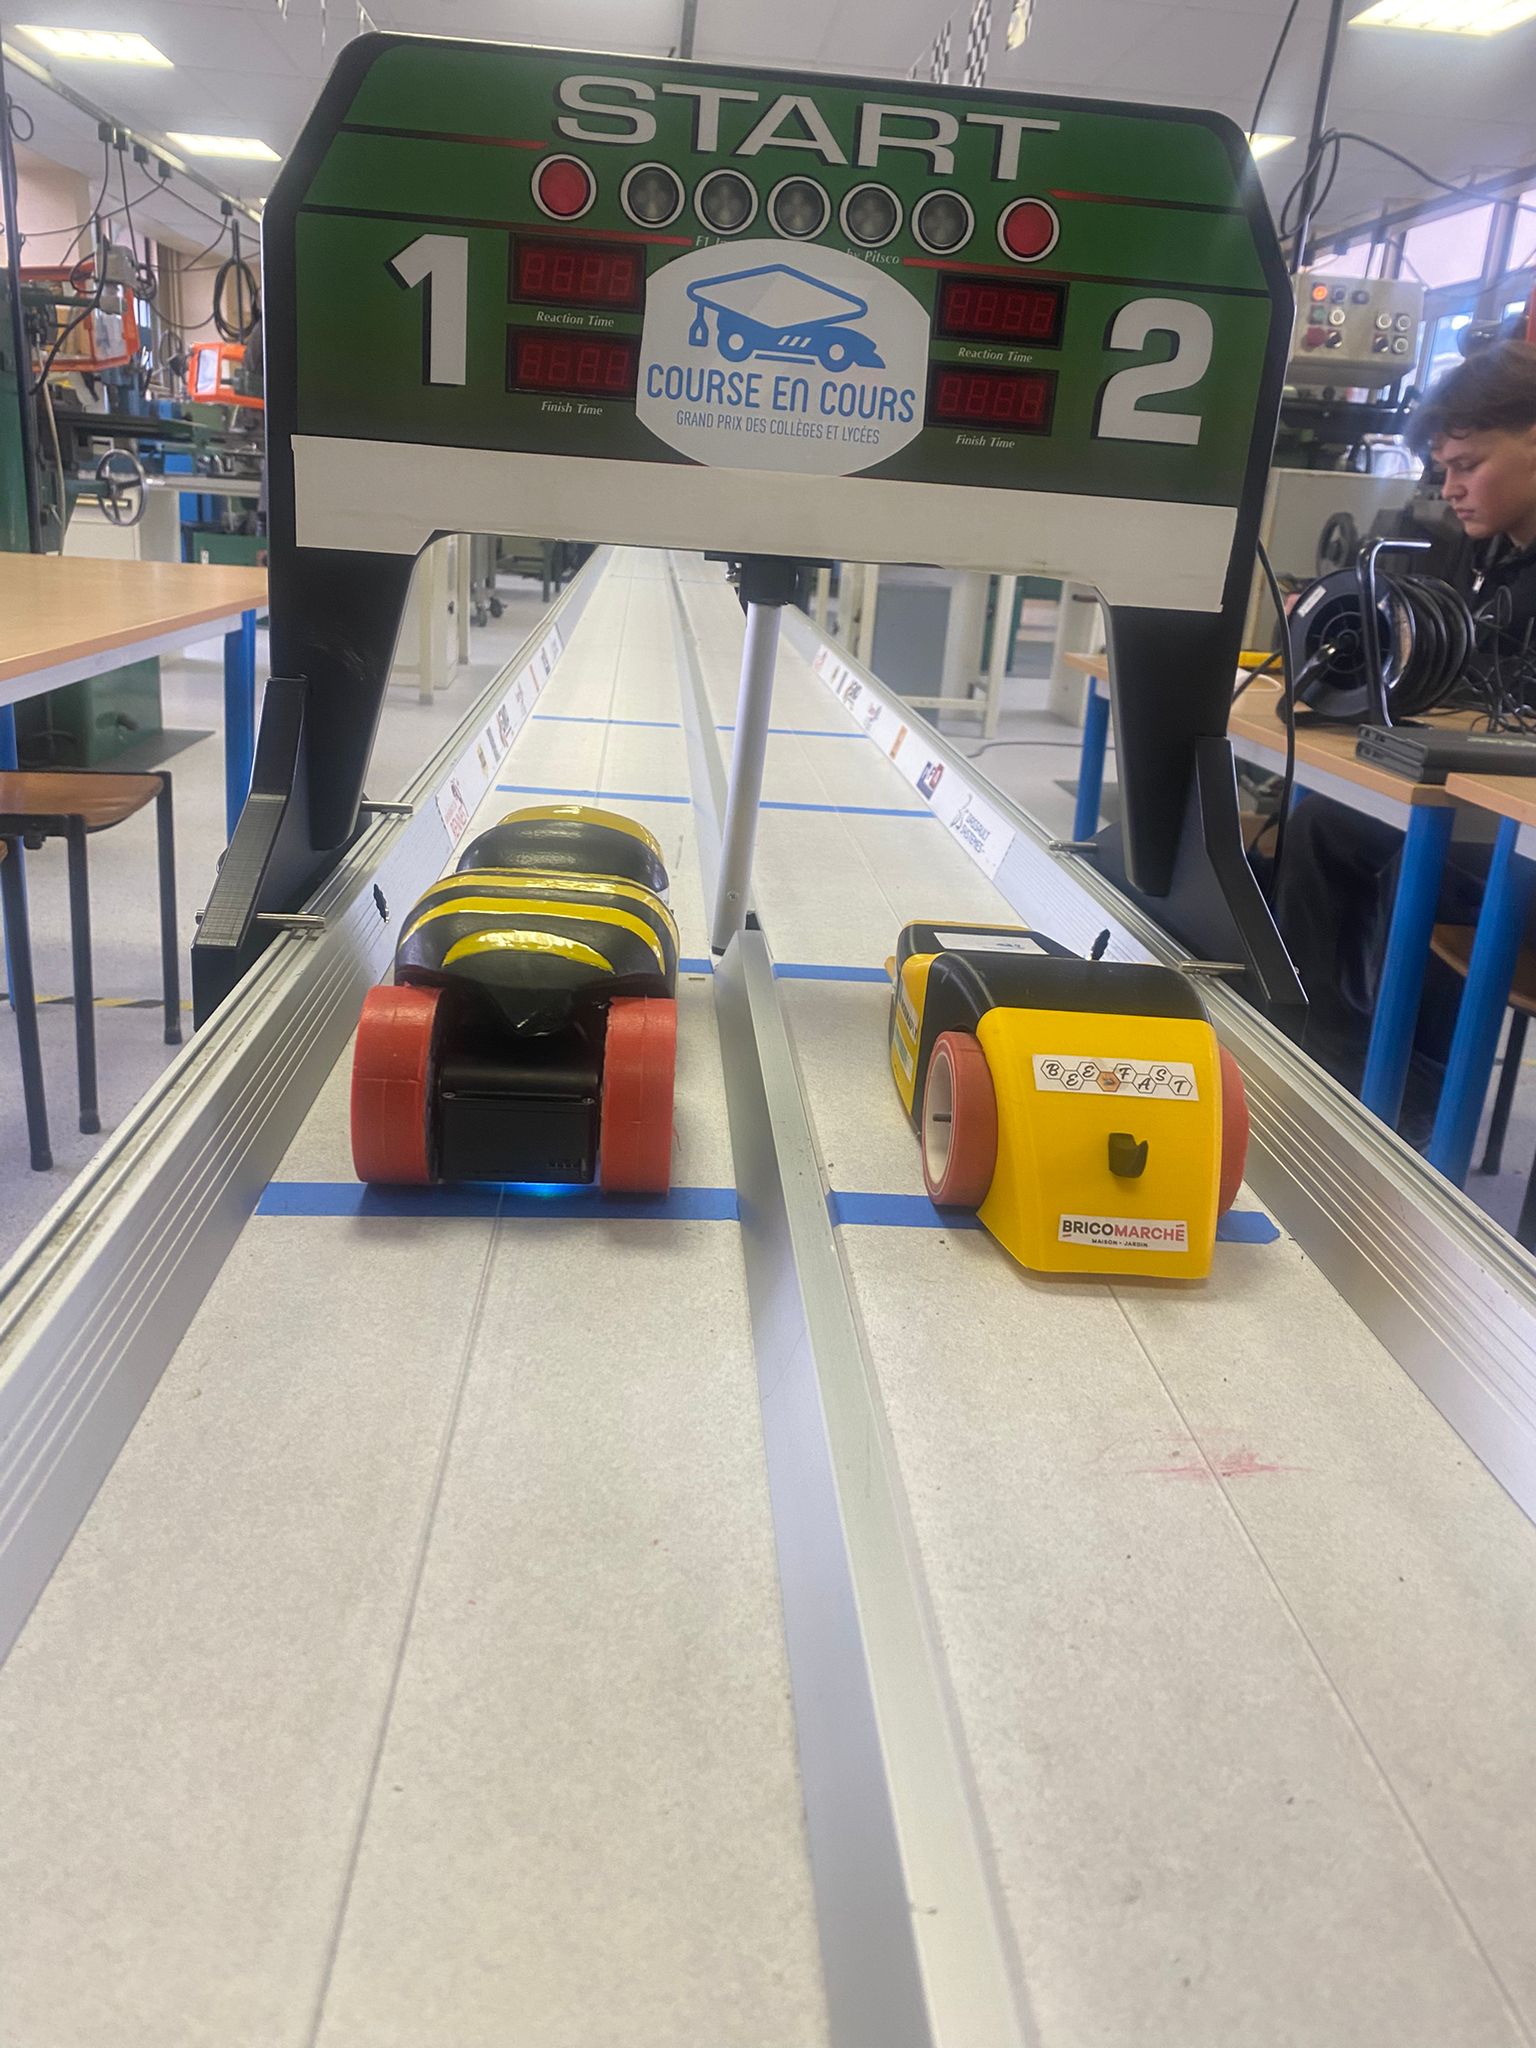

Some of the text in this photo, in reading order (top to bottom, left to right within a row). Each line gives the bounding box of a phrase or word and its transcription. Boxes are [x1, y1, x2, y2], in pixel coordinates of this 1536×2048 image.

[558, 75, 1060, 181] START
[864, 250, 900, 264] Pitsco
[391, 233, 469, 386] 1
[536, 310, 615, 328] Reaction Time
[958, 346, 1033, 363] Reaction Time
[1098, 297, 1214, 445] 2
[646, 363, 763, 408] COURSE
[819, 380, 916, 423] COURS
[541, 400, 603, 416] Finish Time
[676, 409, 880, 445] GRAND PRIX DES COLLÈGES ET LYCÉES
[955, 434, 1015, 449] Finish Time
[1062, 1220, 1185, 1241] BRICOMARCHÉ
[1091, 1238, 1118, 1246] MAISON
